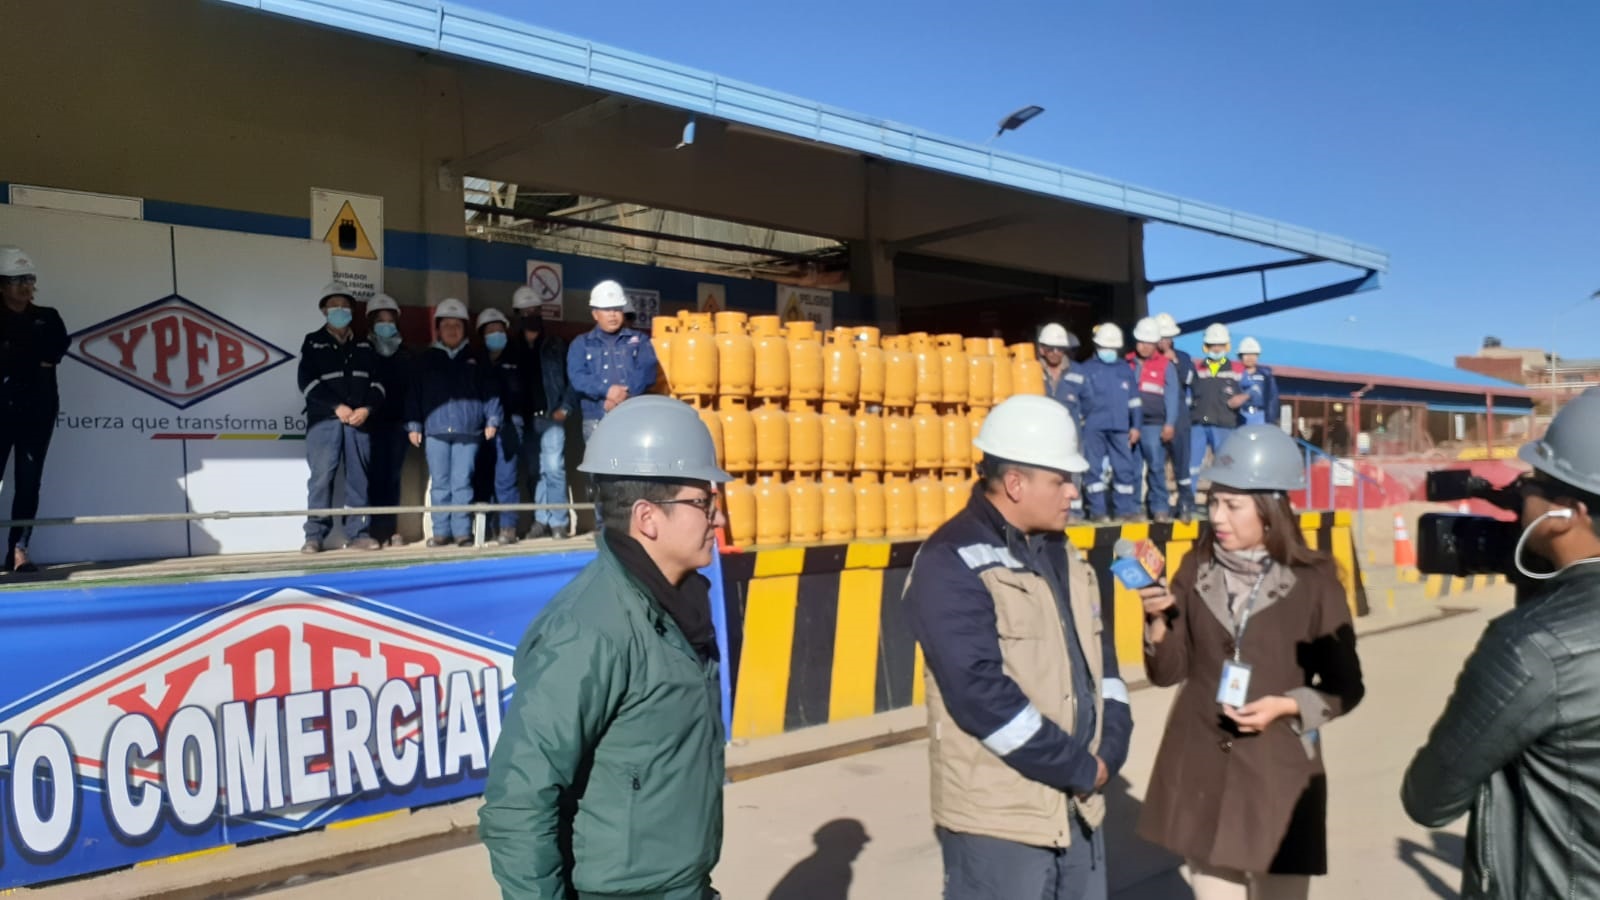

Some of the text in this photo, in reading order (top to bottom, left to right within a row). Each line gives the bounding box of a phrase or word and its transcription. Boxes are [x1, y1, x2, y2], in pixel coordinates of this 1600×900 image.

[108, 315, 245, 389] YPFB
[56, 411, 306, 436] Fuerza que transforma Bo
